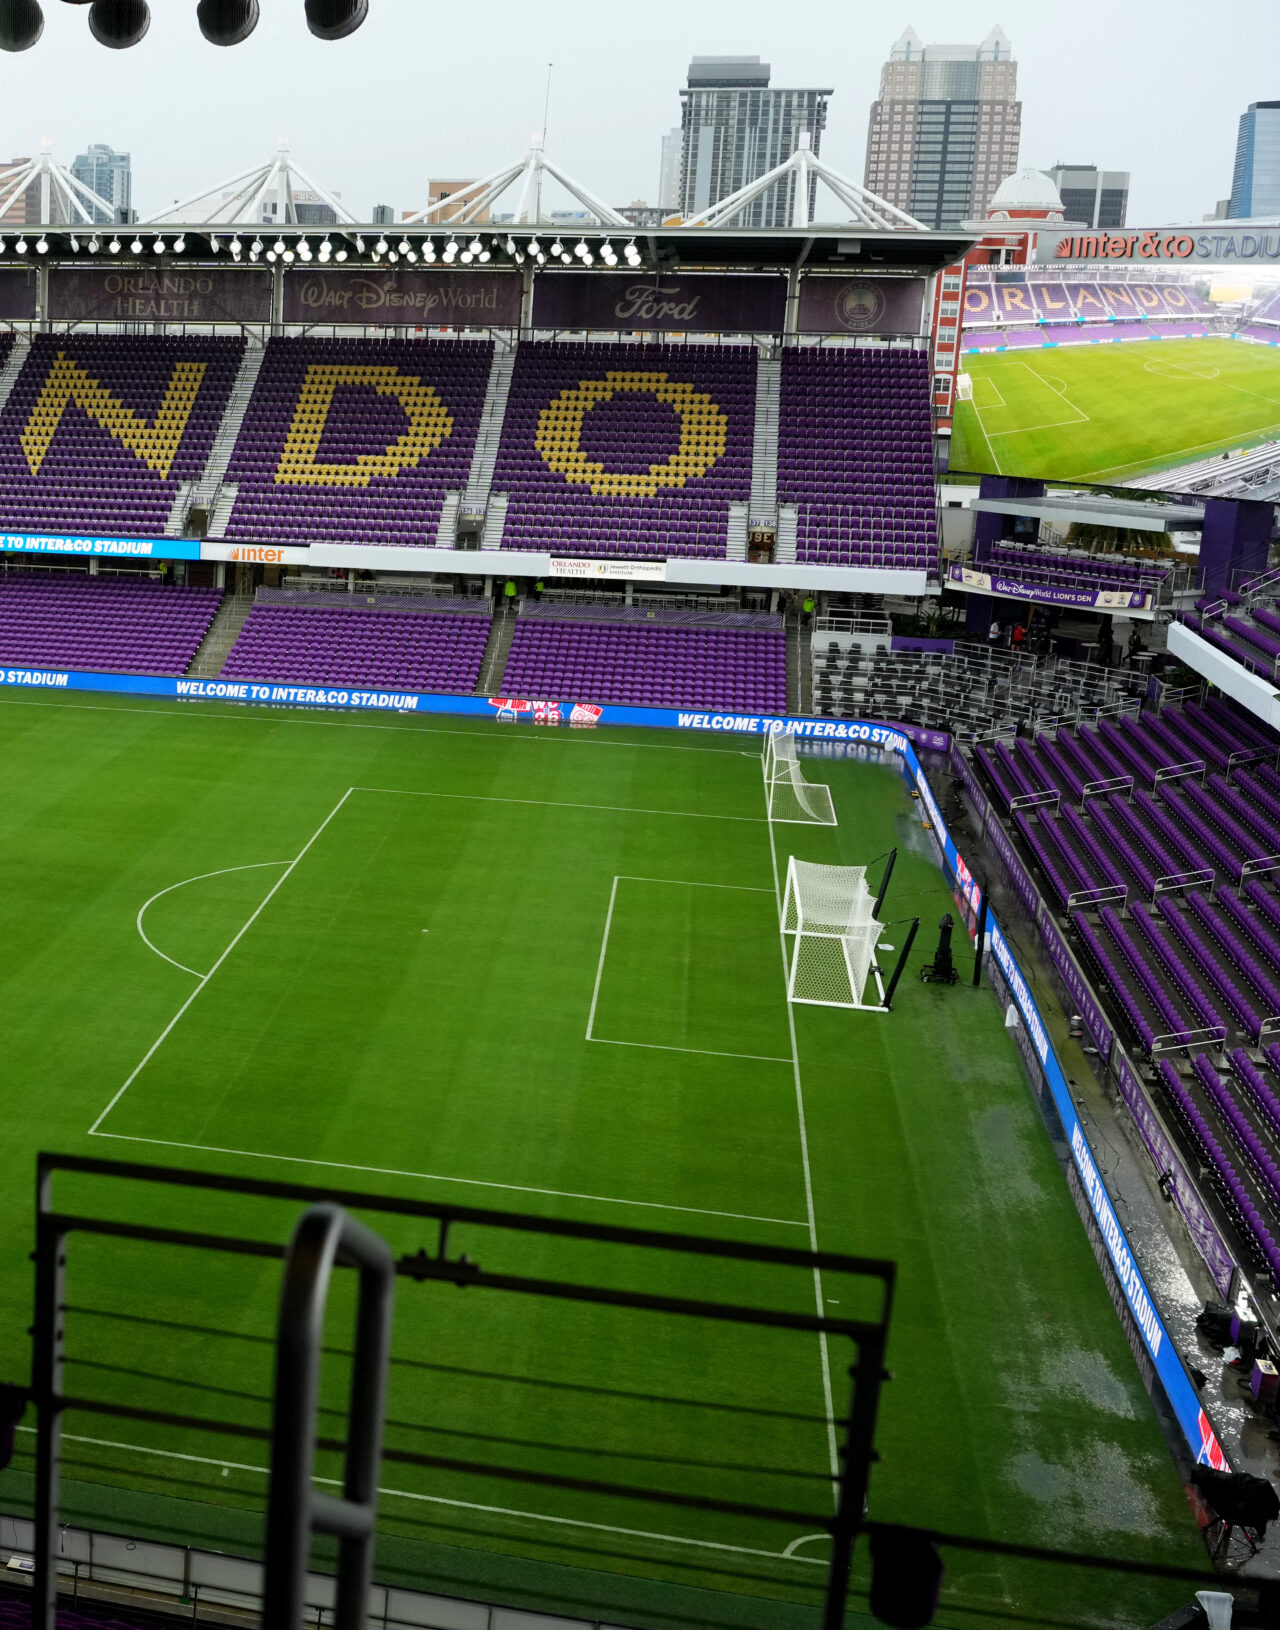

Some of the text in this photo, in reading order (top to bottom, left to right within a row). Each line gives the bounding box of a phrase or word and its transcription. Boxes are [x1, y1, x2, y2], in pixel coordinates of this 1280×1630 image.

[1073, 232, 1195, 258] inter&co
[104, 274, 214, 294] ORLANDO
[117, 296, 200, 317] HEALTH
[440, 287, 498, 309] World
[614, 283, 701, 321] Ford
[6, 536, 24, 549] TO
[25, 537, 93, 553] INTER&CO
[93, 540, 153, 555] STADIUM
[241, 546, 285, 563] inter
[552, 560, 591, 568] ORLANDO
[556, 567, 586, 575] HEALTH
[1053, 592, 1076, 601] LION'S
[1077, 594, 1092, 602] DEN
[6, 670, 69, 686] STADIUM
[176, 681, 418, 709] WELCOME TO INTER&CO STADIUM
[677, 713, 758, 732] WELCOME
[762, 719, 785, 733] TO
[786, 721, 870, 739] INTER&CO
[1072, 1121, 1163, 1358] WELCOME TO INTER&CO STADIUM
